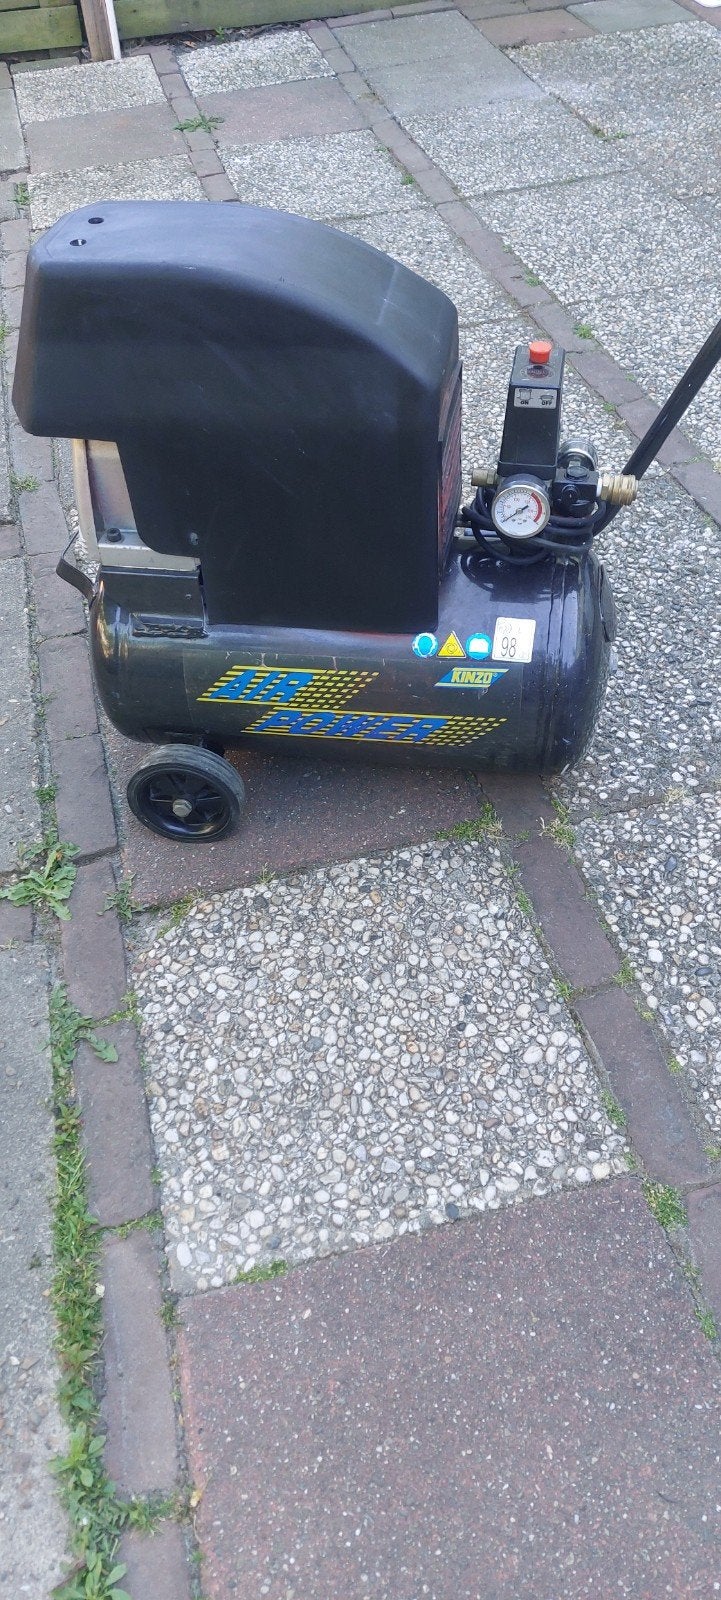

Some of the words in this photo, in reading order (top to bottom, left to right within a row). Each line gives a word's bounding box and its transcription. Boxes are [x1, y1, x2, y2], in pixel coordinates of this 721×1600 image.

[501, 637, 517, 658] 98
[210, 669, 314, 703] AIR
[450, 671, 493, 684] KINZO
[254, 710, 448, 742] POWER
